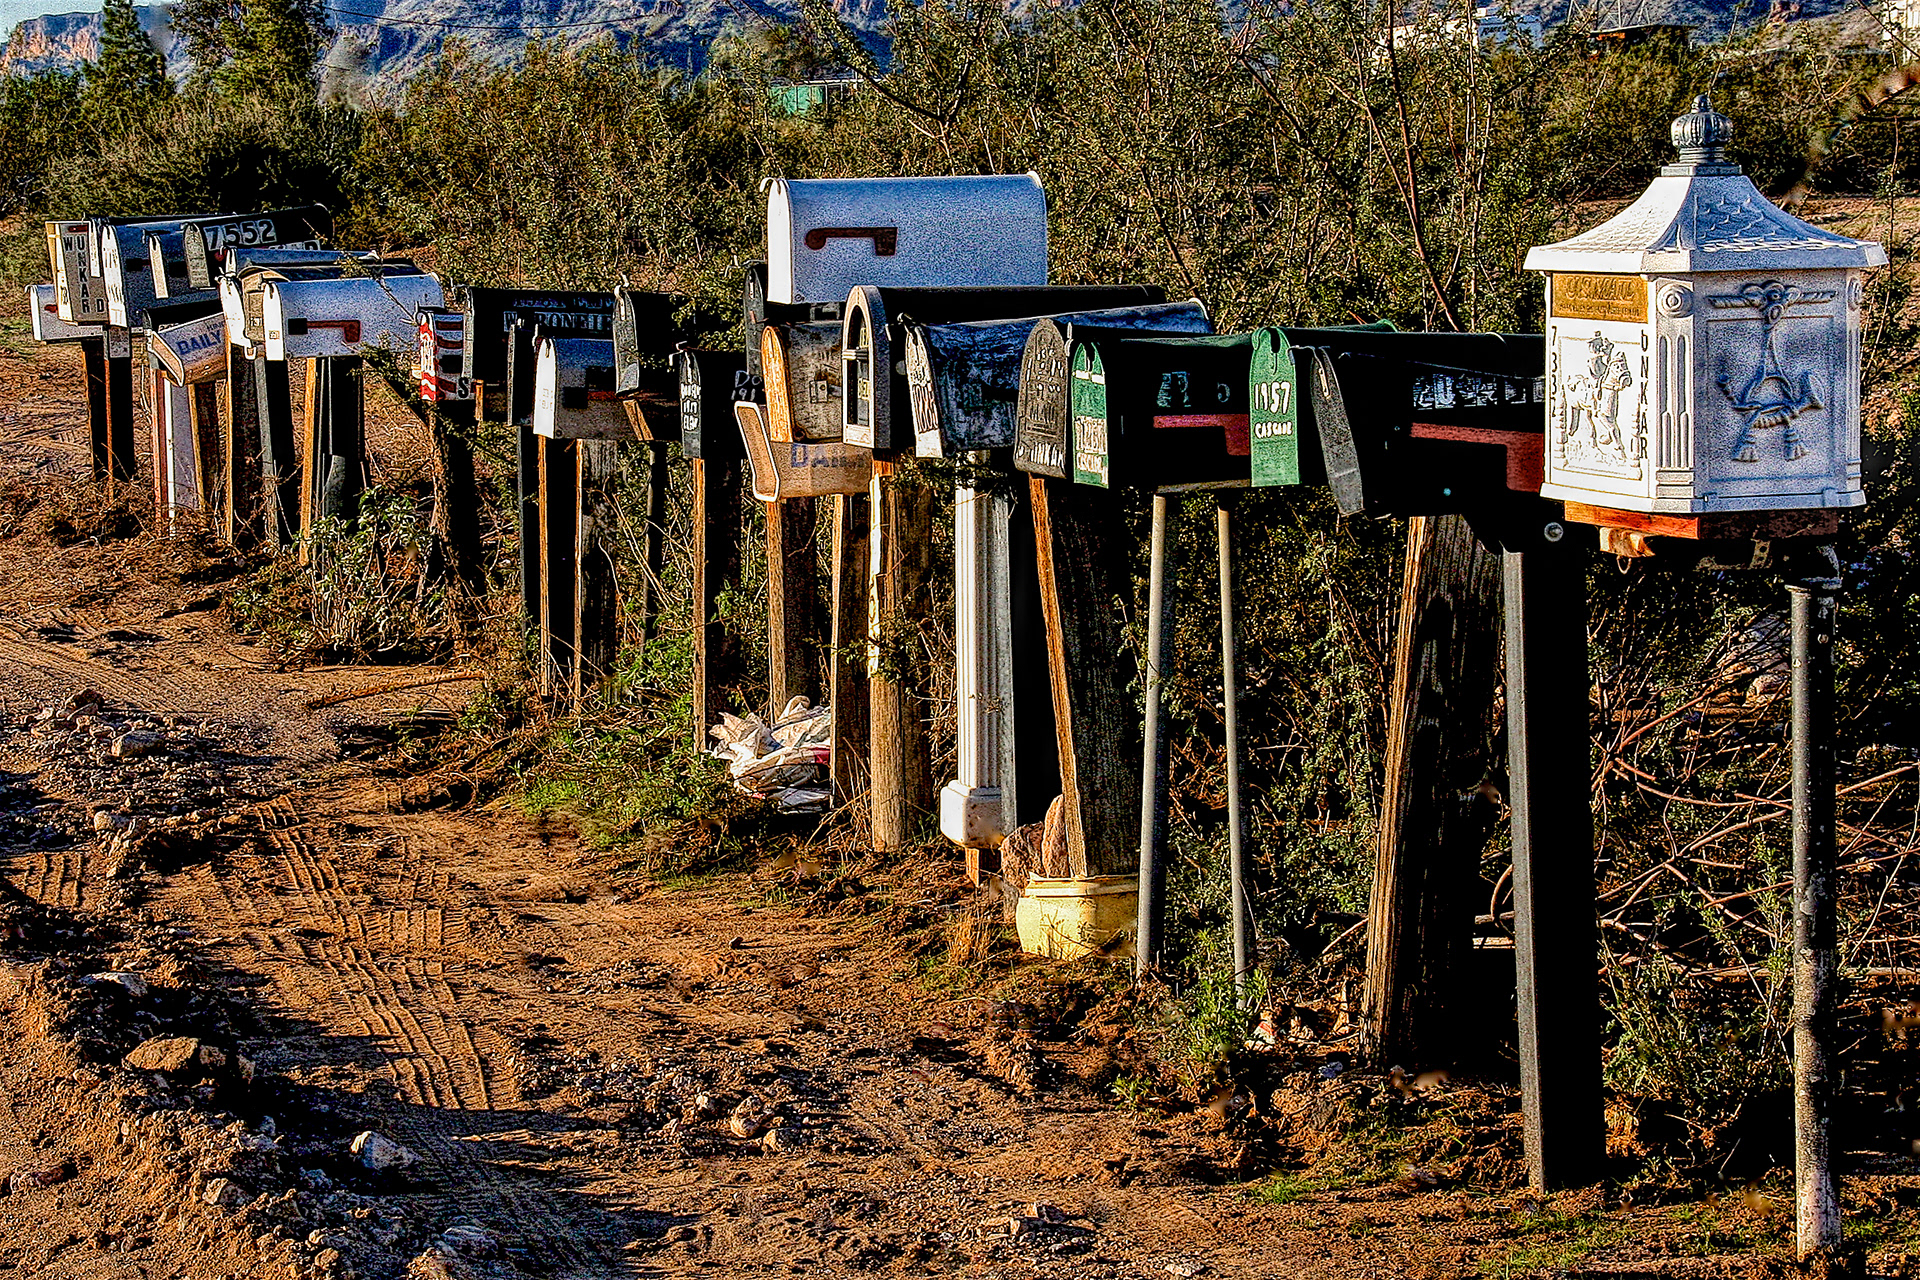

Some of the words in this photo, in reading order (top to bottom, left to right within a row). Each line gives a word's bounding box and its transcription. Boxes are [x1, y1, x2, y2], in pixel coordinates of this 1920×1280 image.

[204, 220, 277, 250] 7552
[178, 330, 222, 356] DAILY
[1254, 381, 1291, 415] 1957
